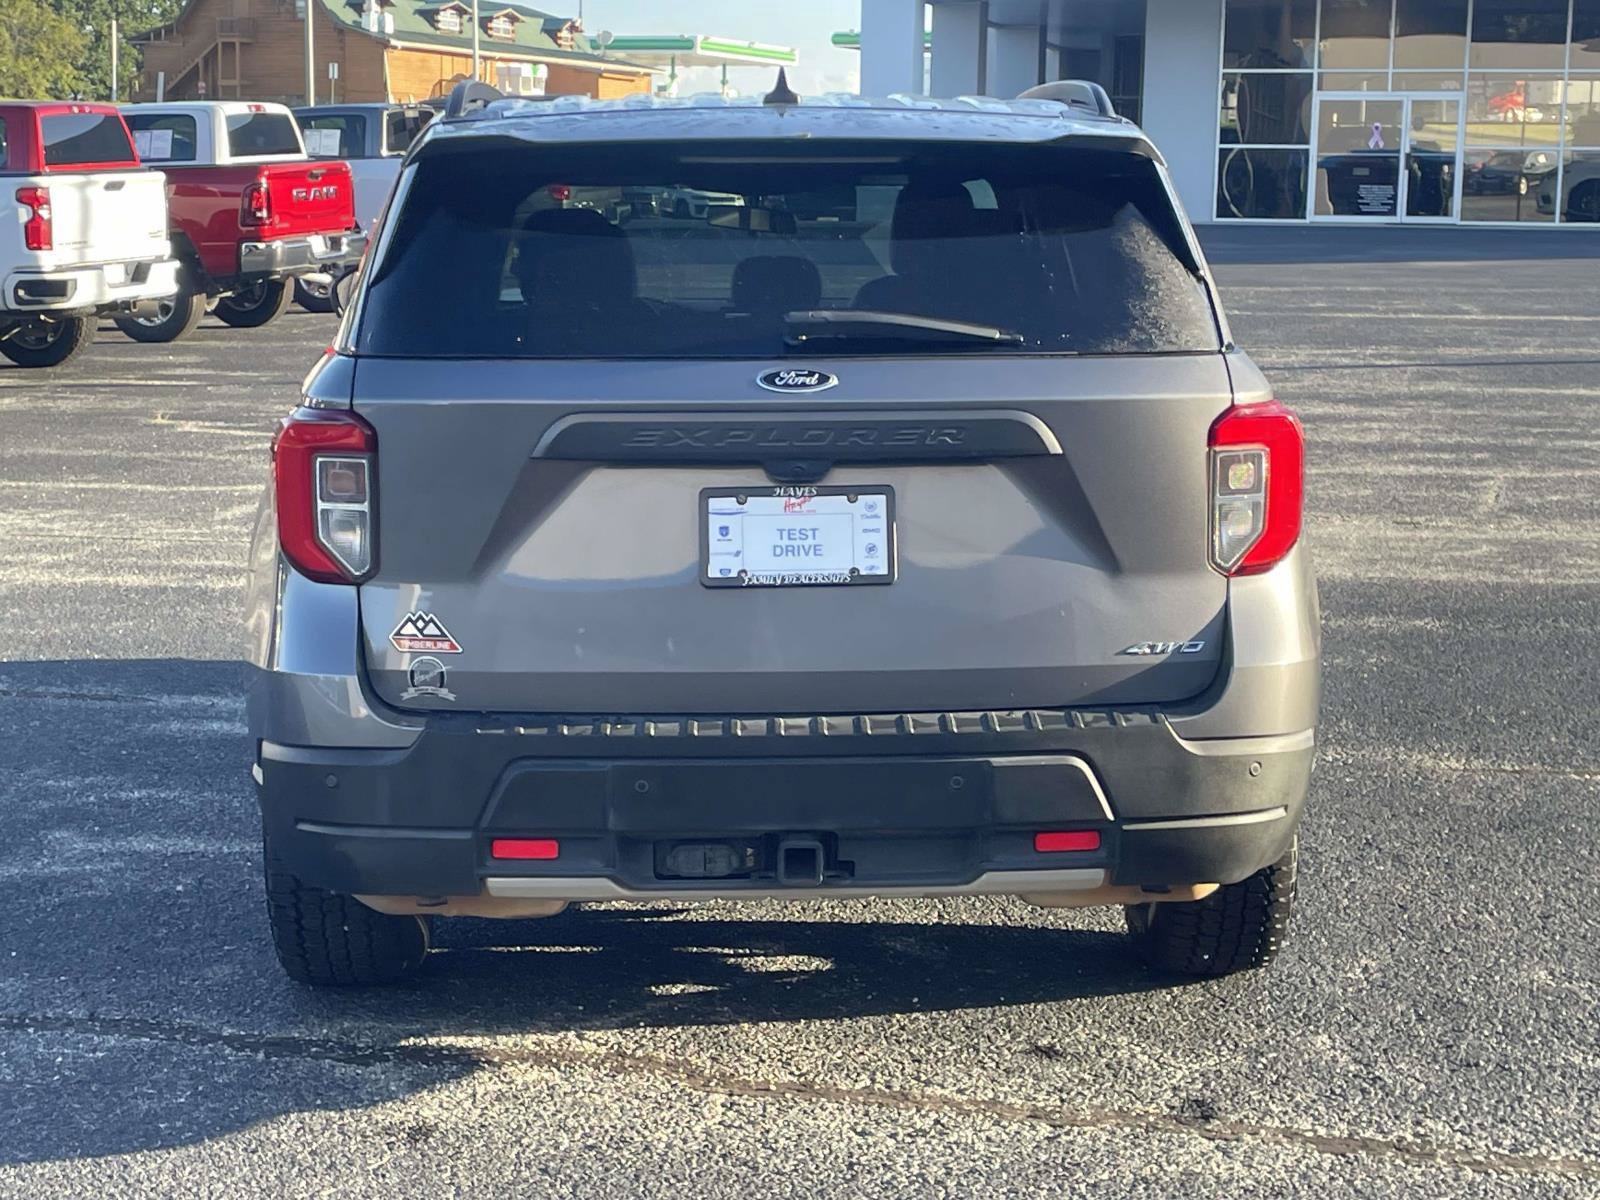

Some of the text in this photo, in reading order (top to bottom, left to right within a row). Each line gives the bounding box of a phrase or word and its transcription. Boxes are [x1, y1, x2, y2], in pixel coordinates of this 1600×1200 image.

[774, 370, 819, 385] Ford
[621, 427, 966, 447] EXPLORER
[773, 486, 817, 498] HAYES
[776, 528, 819, 541] TEST
[773, 544, 824, 557] DRIVE
[742, 573, 782, 586] FAMILY
[1114, 641, 1205, 656] 4WD
